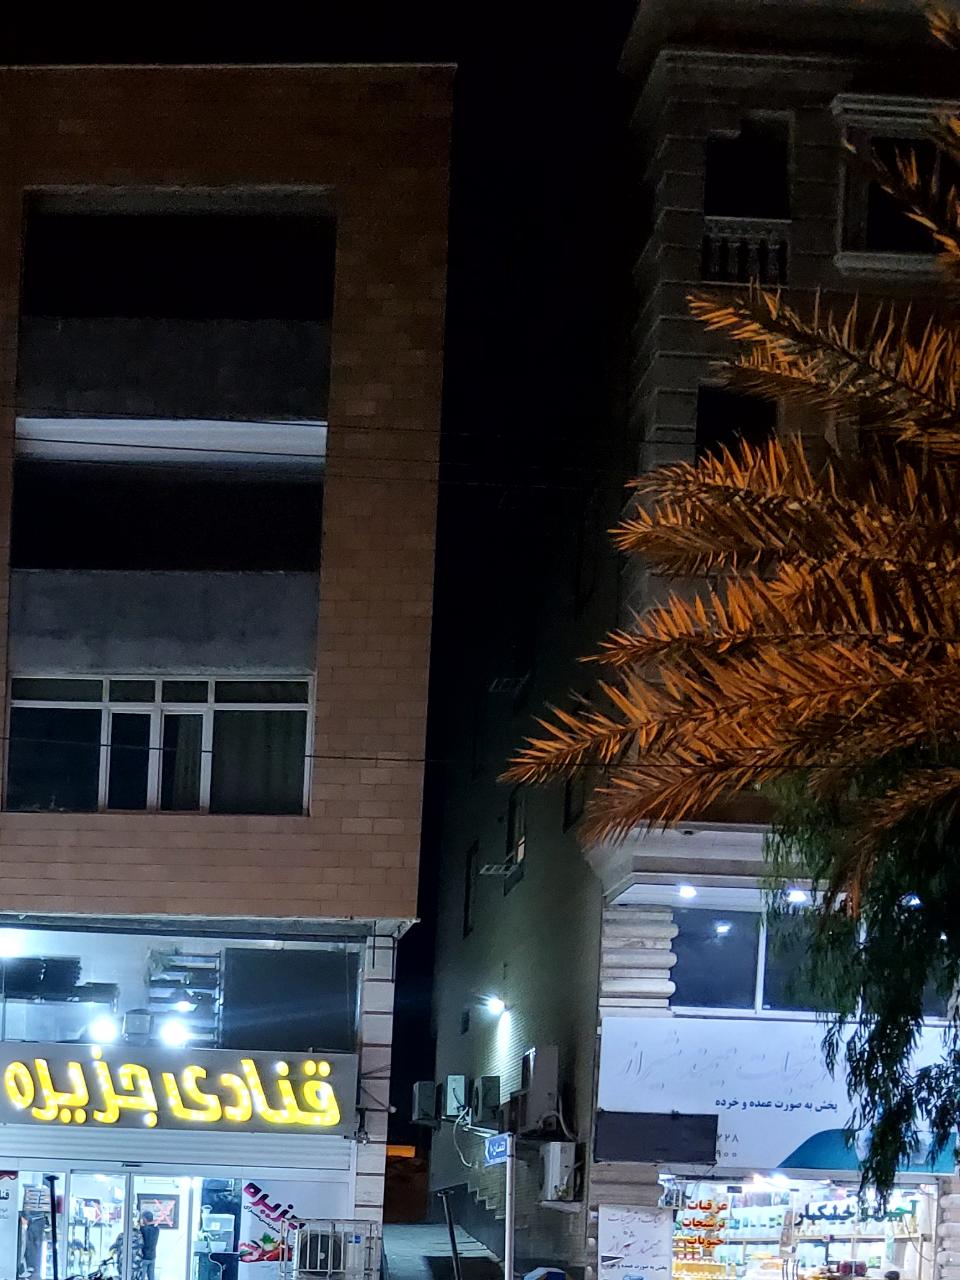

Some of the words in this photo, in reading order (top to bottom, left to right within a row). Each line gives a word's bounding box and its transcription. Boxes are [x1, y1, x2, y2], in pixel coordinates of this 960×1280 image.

[4, 1045, 159, 1128] جزیره
[161, 1059, 341, 1126] قنادی
[715, 1097, 739, 1110] خرده
[742, 1102, 747, 1110] و
[749, 1100, 771, 1108] عمده
[774, 1101, 802, 1112] صورت
[804, 1102, 813, 1111] به
[815, 1100, 838, 1113] پخش
